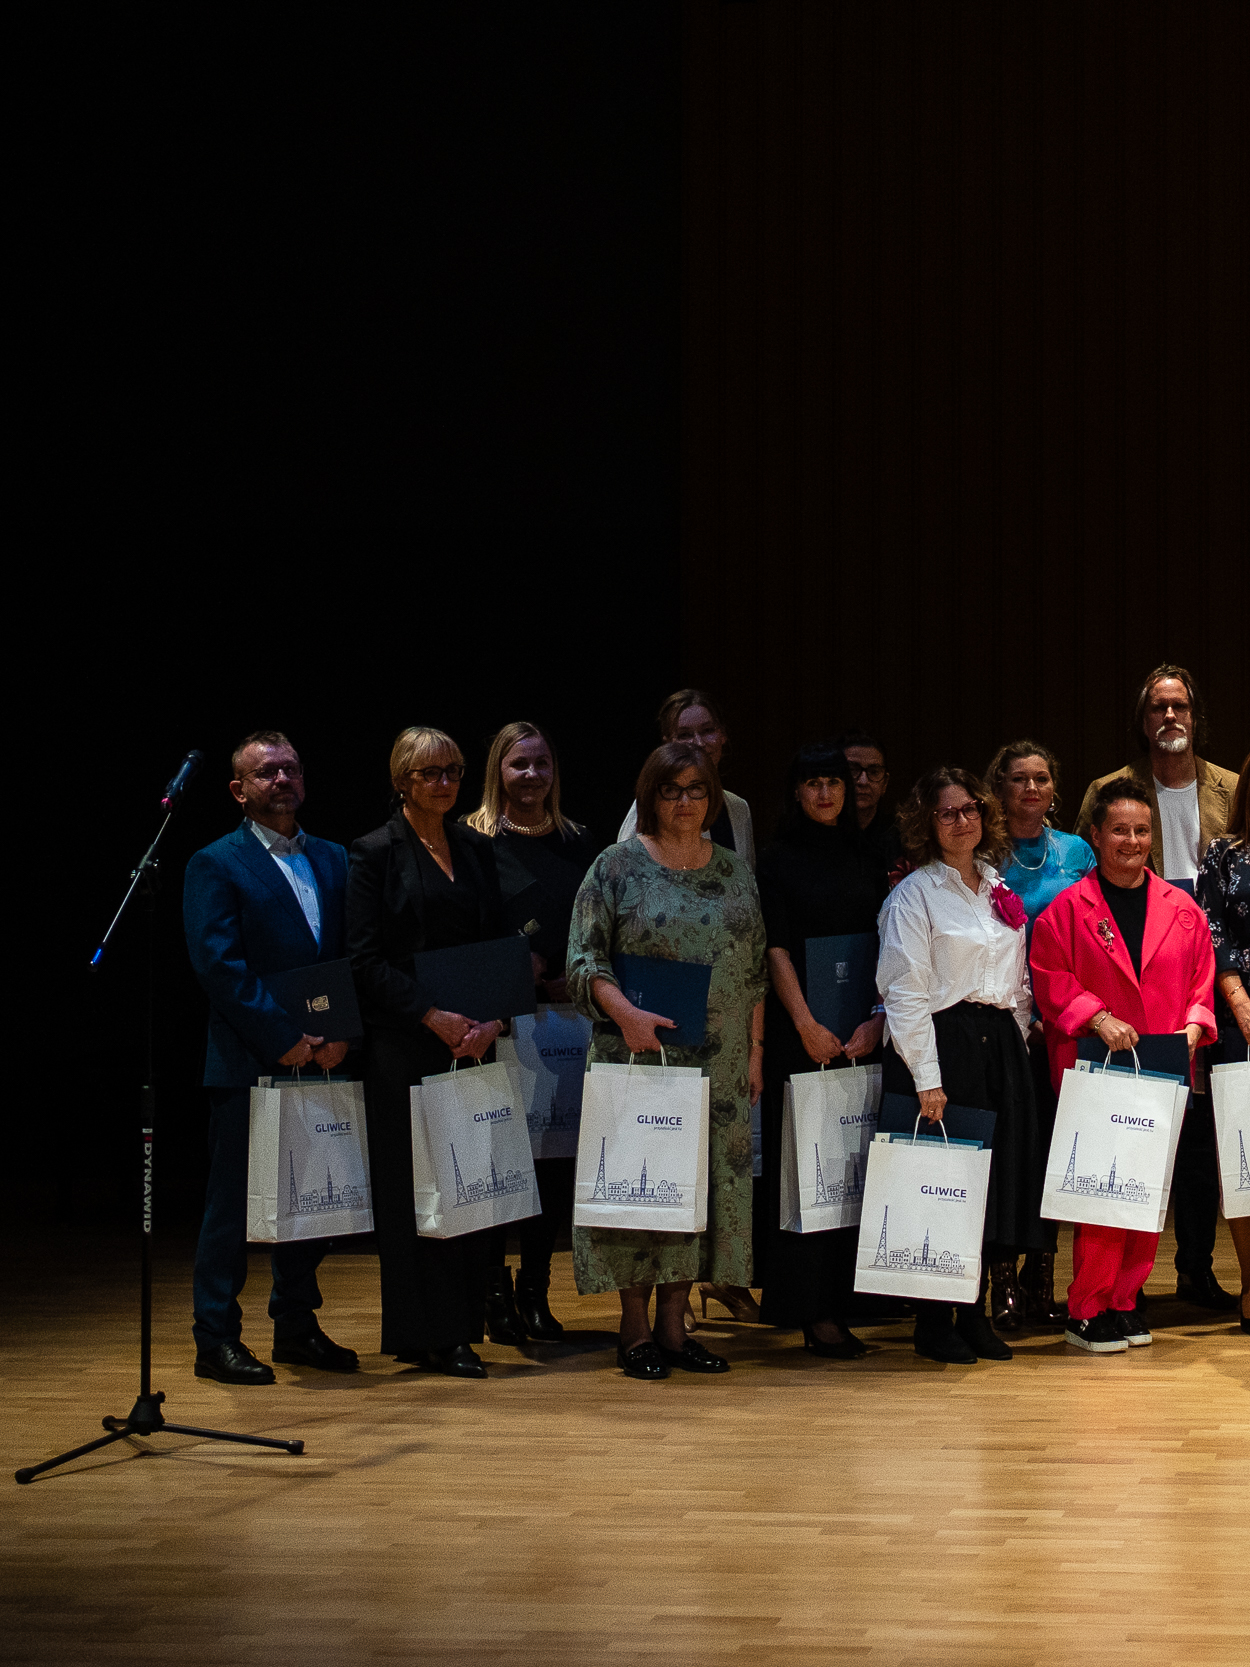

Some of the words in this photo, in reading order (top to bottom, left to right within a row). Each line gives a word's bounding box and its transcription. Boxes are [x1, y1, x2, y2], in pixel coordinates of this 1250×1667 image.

[541, 1047, 583, 1057] GLIWICE
[474, 1107, 512, 1122] GLIWICE
[637, 1114, 682, 1125] GLIWICE
[840, 1112, 879, 1125] GLIWICE
[1110, 1114, 1155, 1128] GLIWICE
[315, 1121, 351, 1133] GLIWICE
[144, 1142, 153, 1233] DYNAWID
[921, 1185, 967, 1198] GLIWICE
